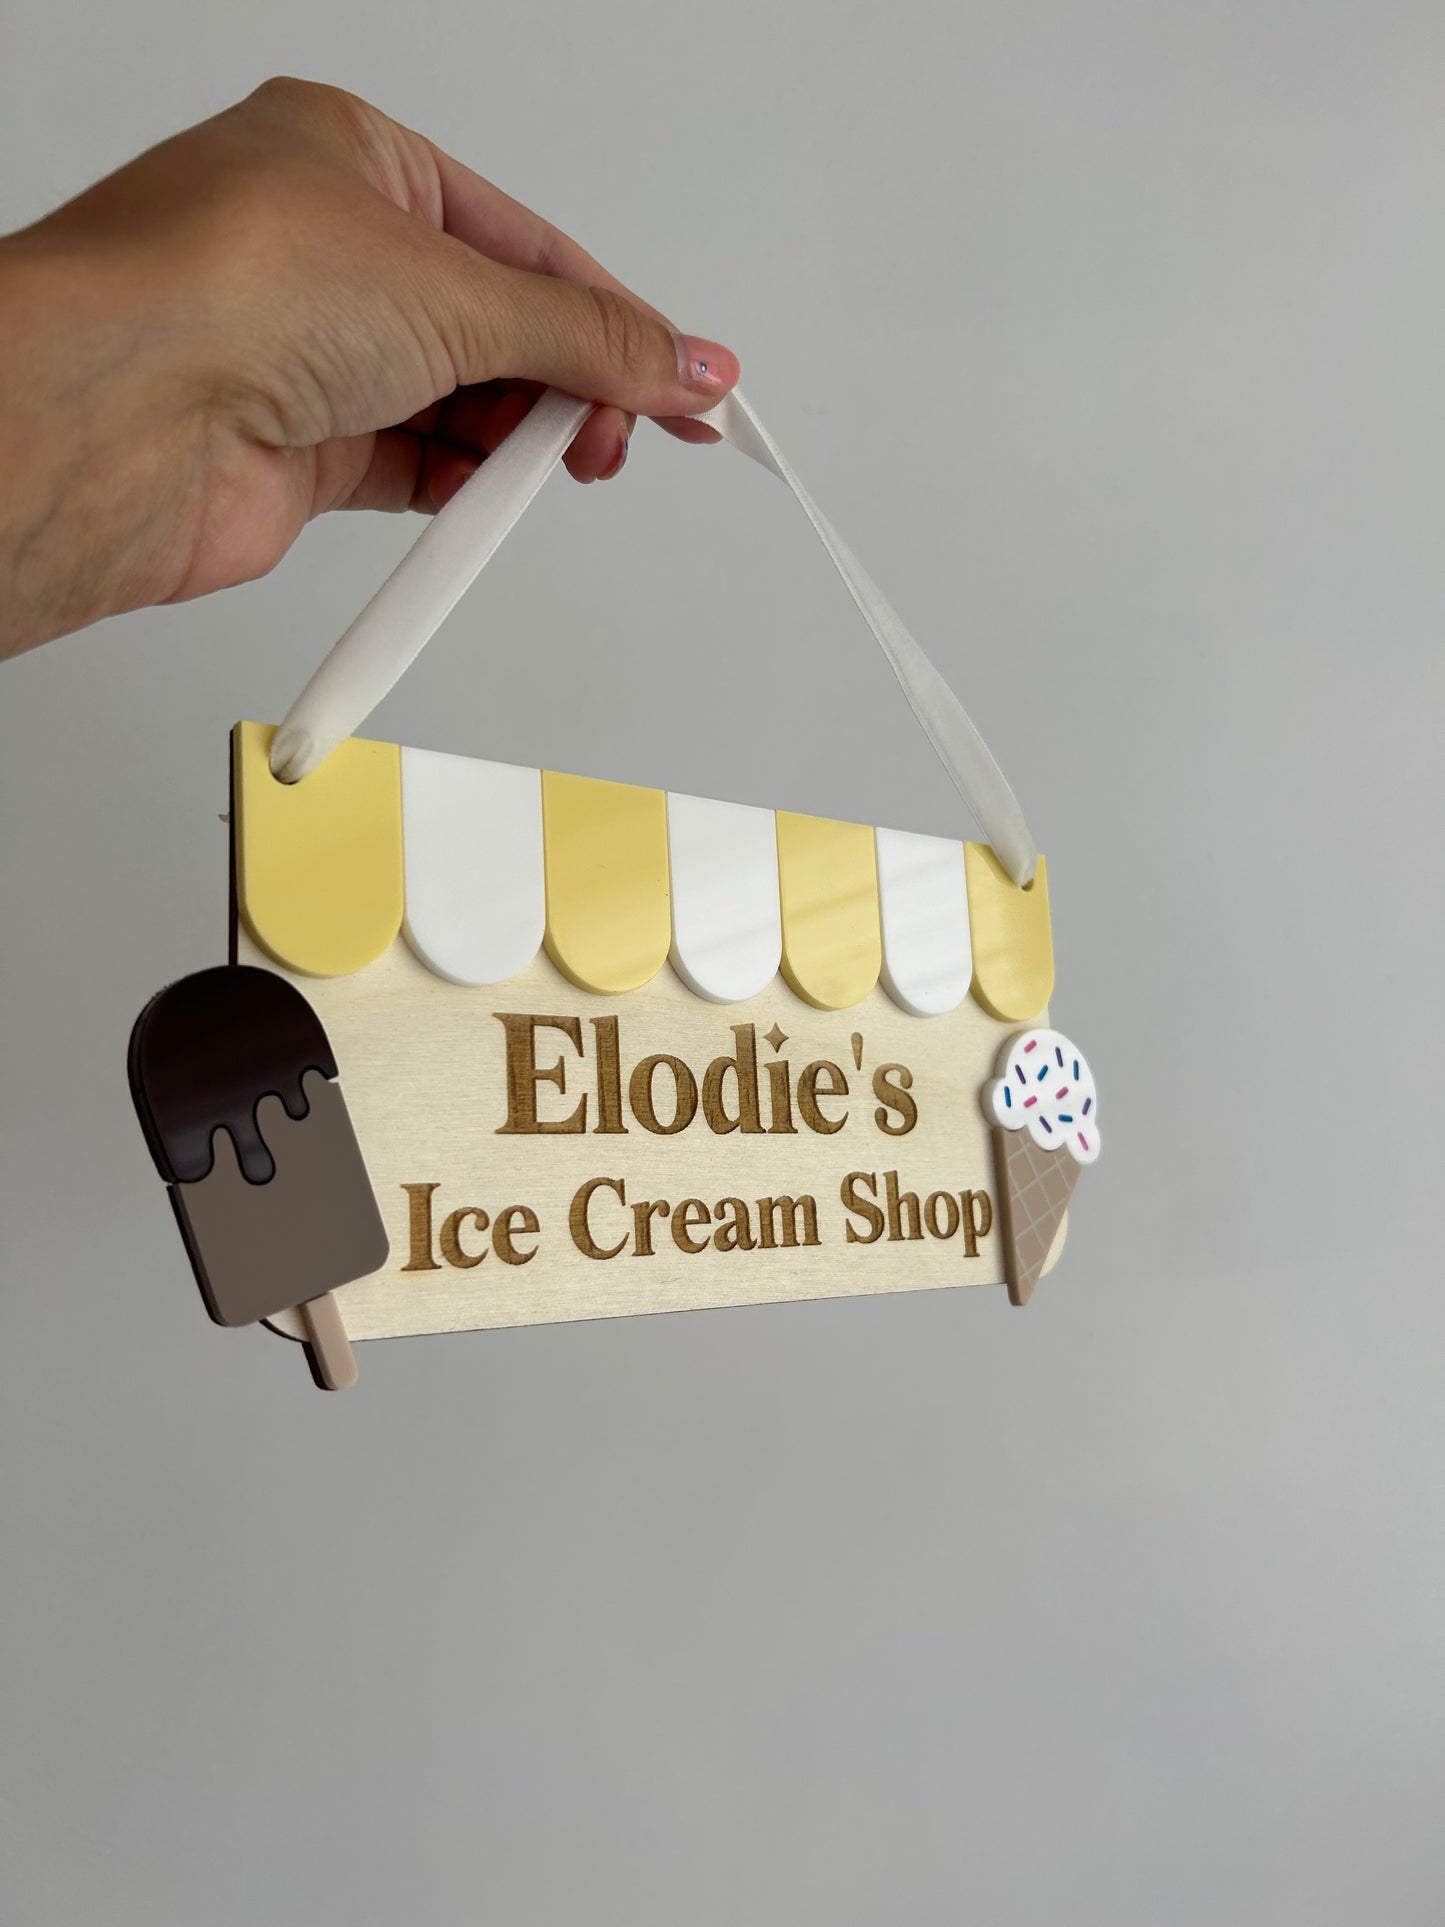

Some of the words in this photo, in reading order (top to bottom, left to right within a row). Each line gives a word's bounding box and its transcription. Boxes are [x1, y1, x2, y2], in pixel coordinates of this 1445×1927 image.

[493, 1012, 919, 1137] Elodie's
[400, 1182, 541, 1272] Ice
[568, 1176, 822, 1260] Cream
[839, 1170, 993, 1258] Shop
